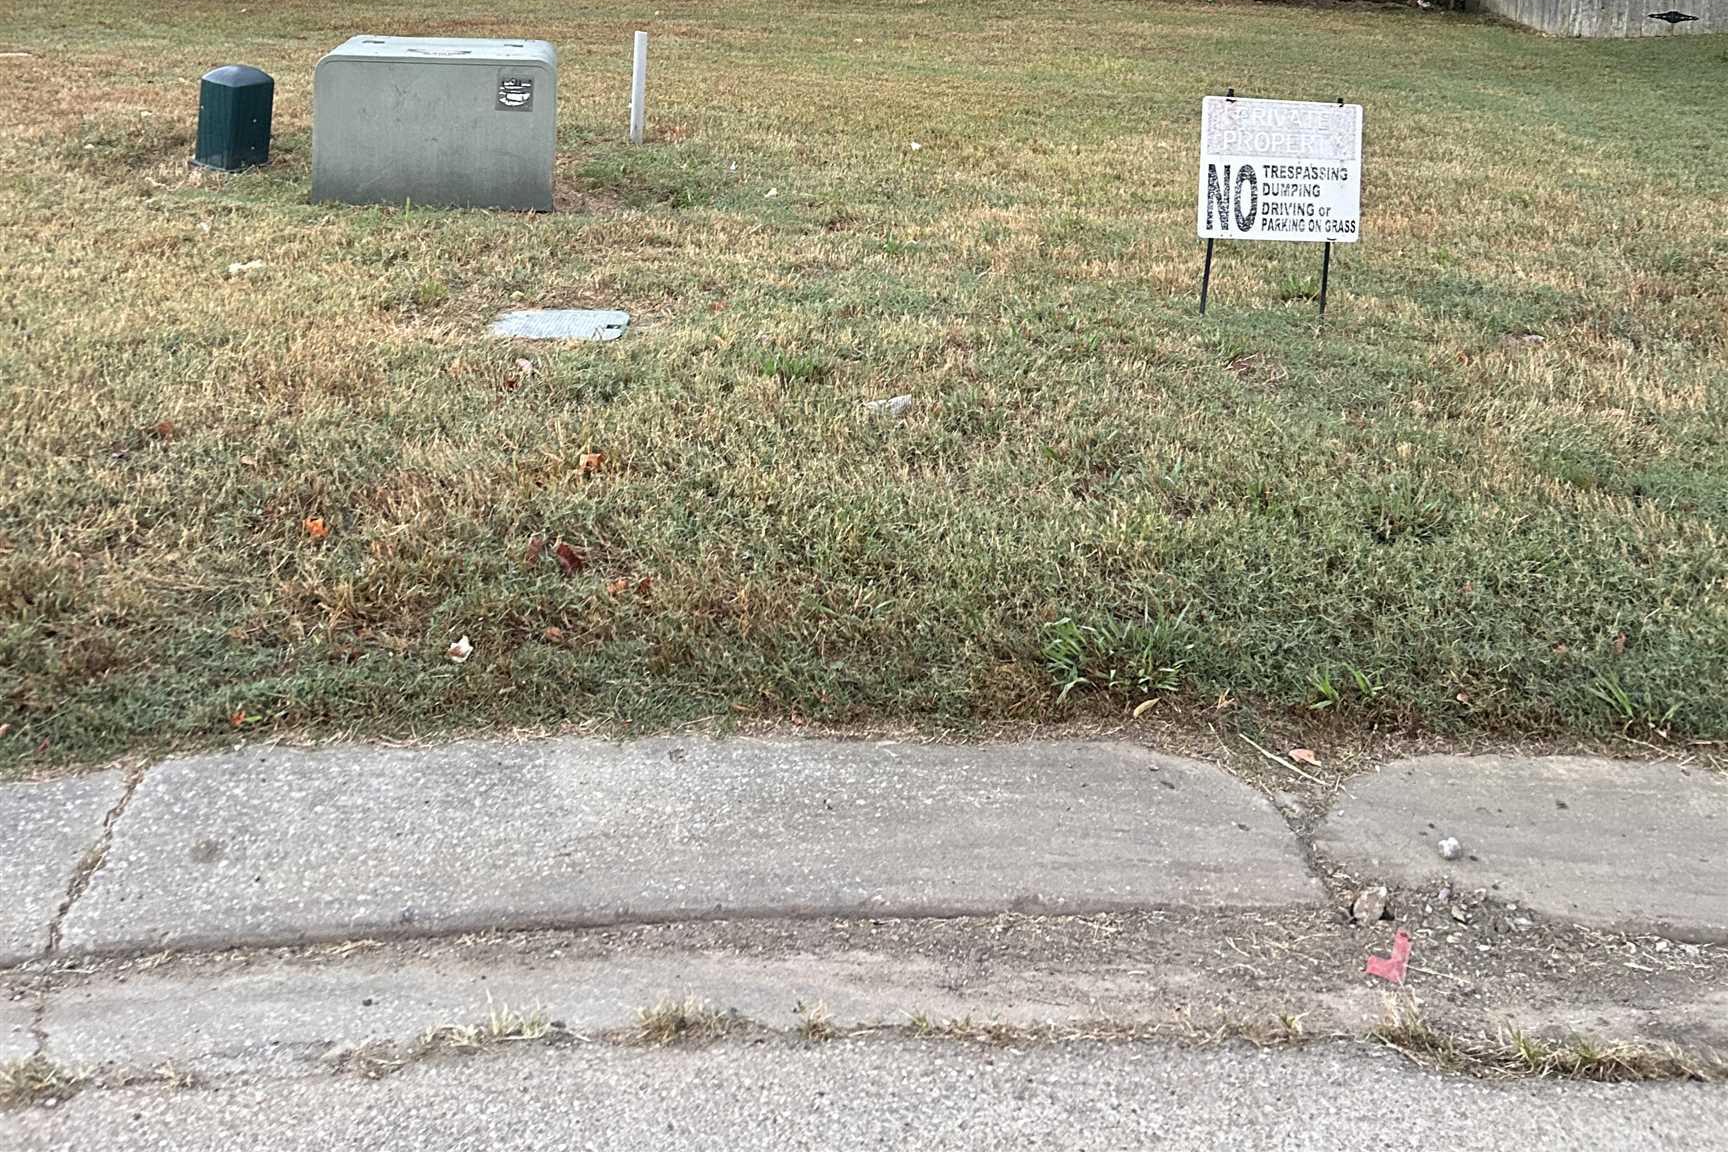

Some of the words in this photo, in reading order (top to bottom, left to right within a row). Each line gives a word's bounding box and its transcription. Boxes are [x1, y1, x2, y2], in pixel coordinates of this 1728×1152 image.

[1263, 164, 1348, 181] TRESPASSING
[1262, 183, 1321, 197] DUMPING
[1206, 164, 1258, 232] NO
[1261, 202, 1315, 216] DRIVING
[1318, 206, 1332, 216] or
[1261, 218, 1305, 232] PARKING
[1308, 220, 1322, 232] ON
[1324, 220, 1356, 233] GRASS
